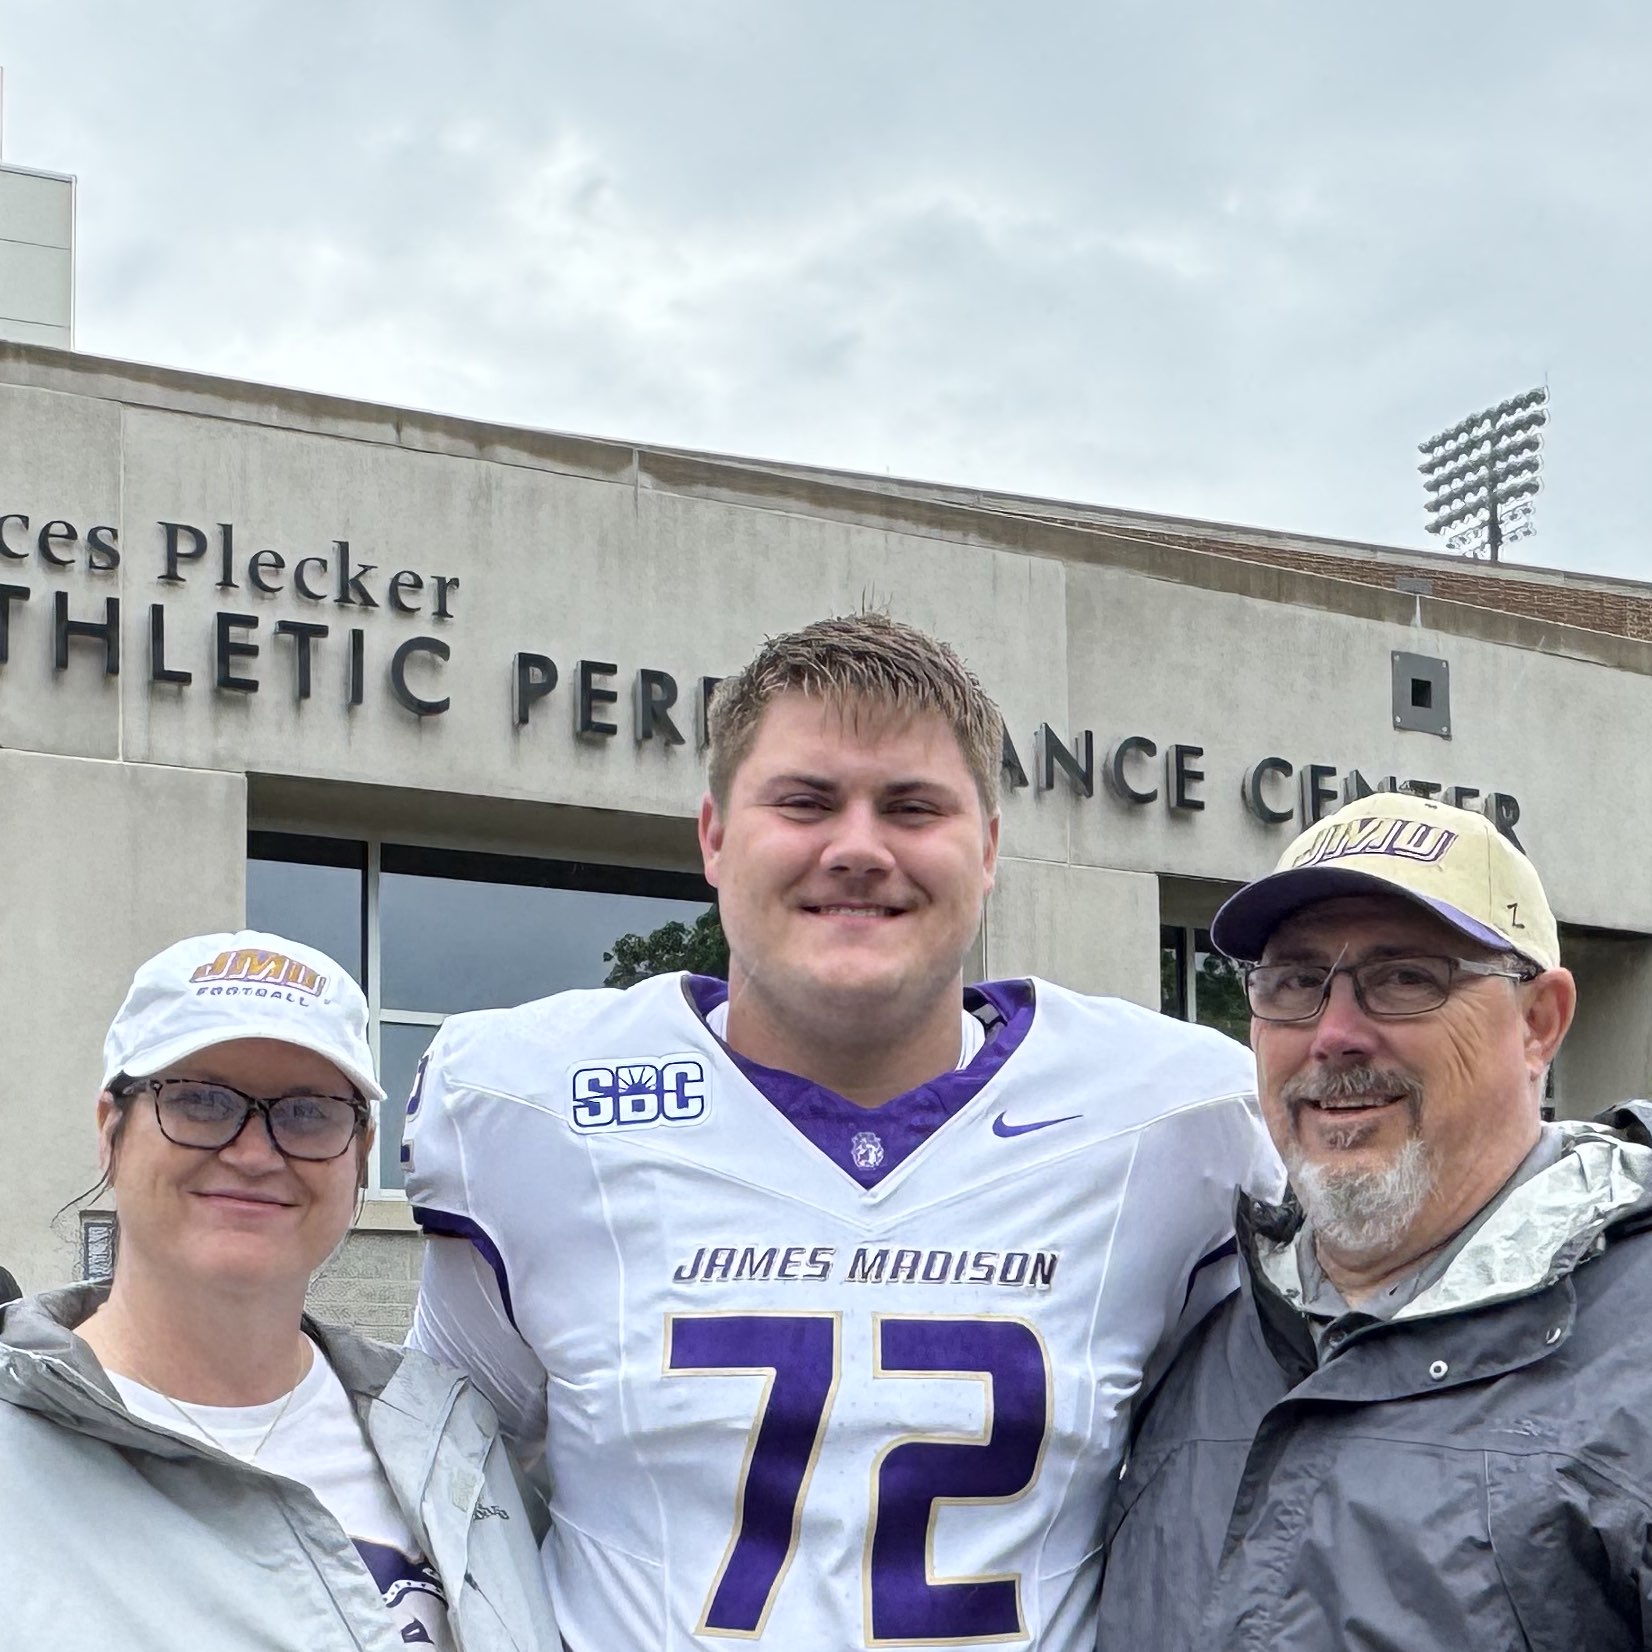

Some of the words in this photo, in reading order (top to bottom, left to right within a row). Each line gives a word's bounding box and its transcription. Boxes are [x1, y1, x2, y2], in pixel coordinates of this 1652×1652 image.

[156, 520, 460, 618] Plecker
[1291, 816, 1459, 868] JMU
[188, 948, 328, 998] JMU
[196, 986, 309, 1007] FOOTBALL
[571, 1060, 705, 1129] SBC
[672, 1247, 836, 1283] JAMES
[844, 1247, 1058, 1289] MADISON
[661, 1311, 1056, 1648] 72
